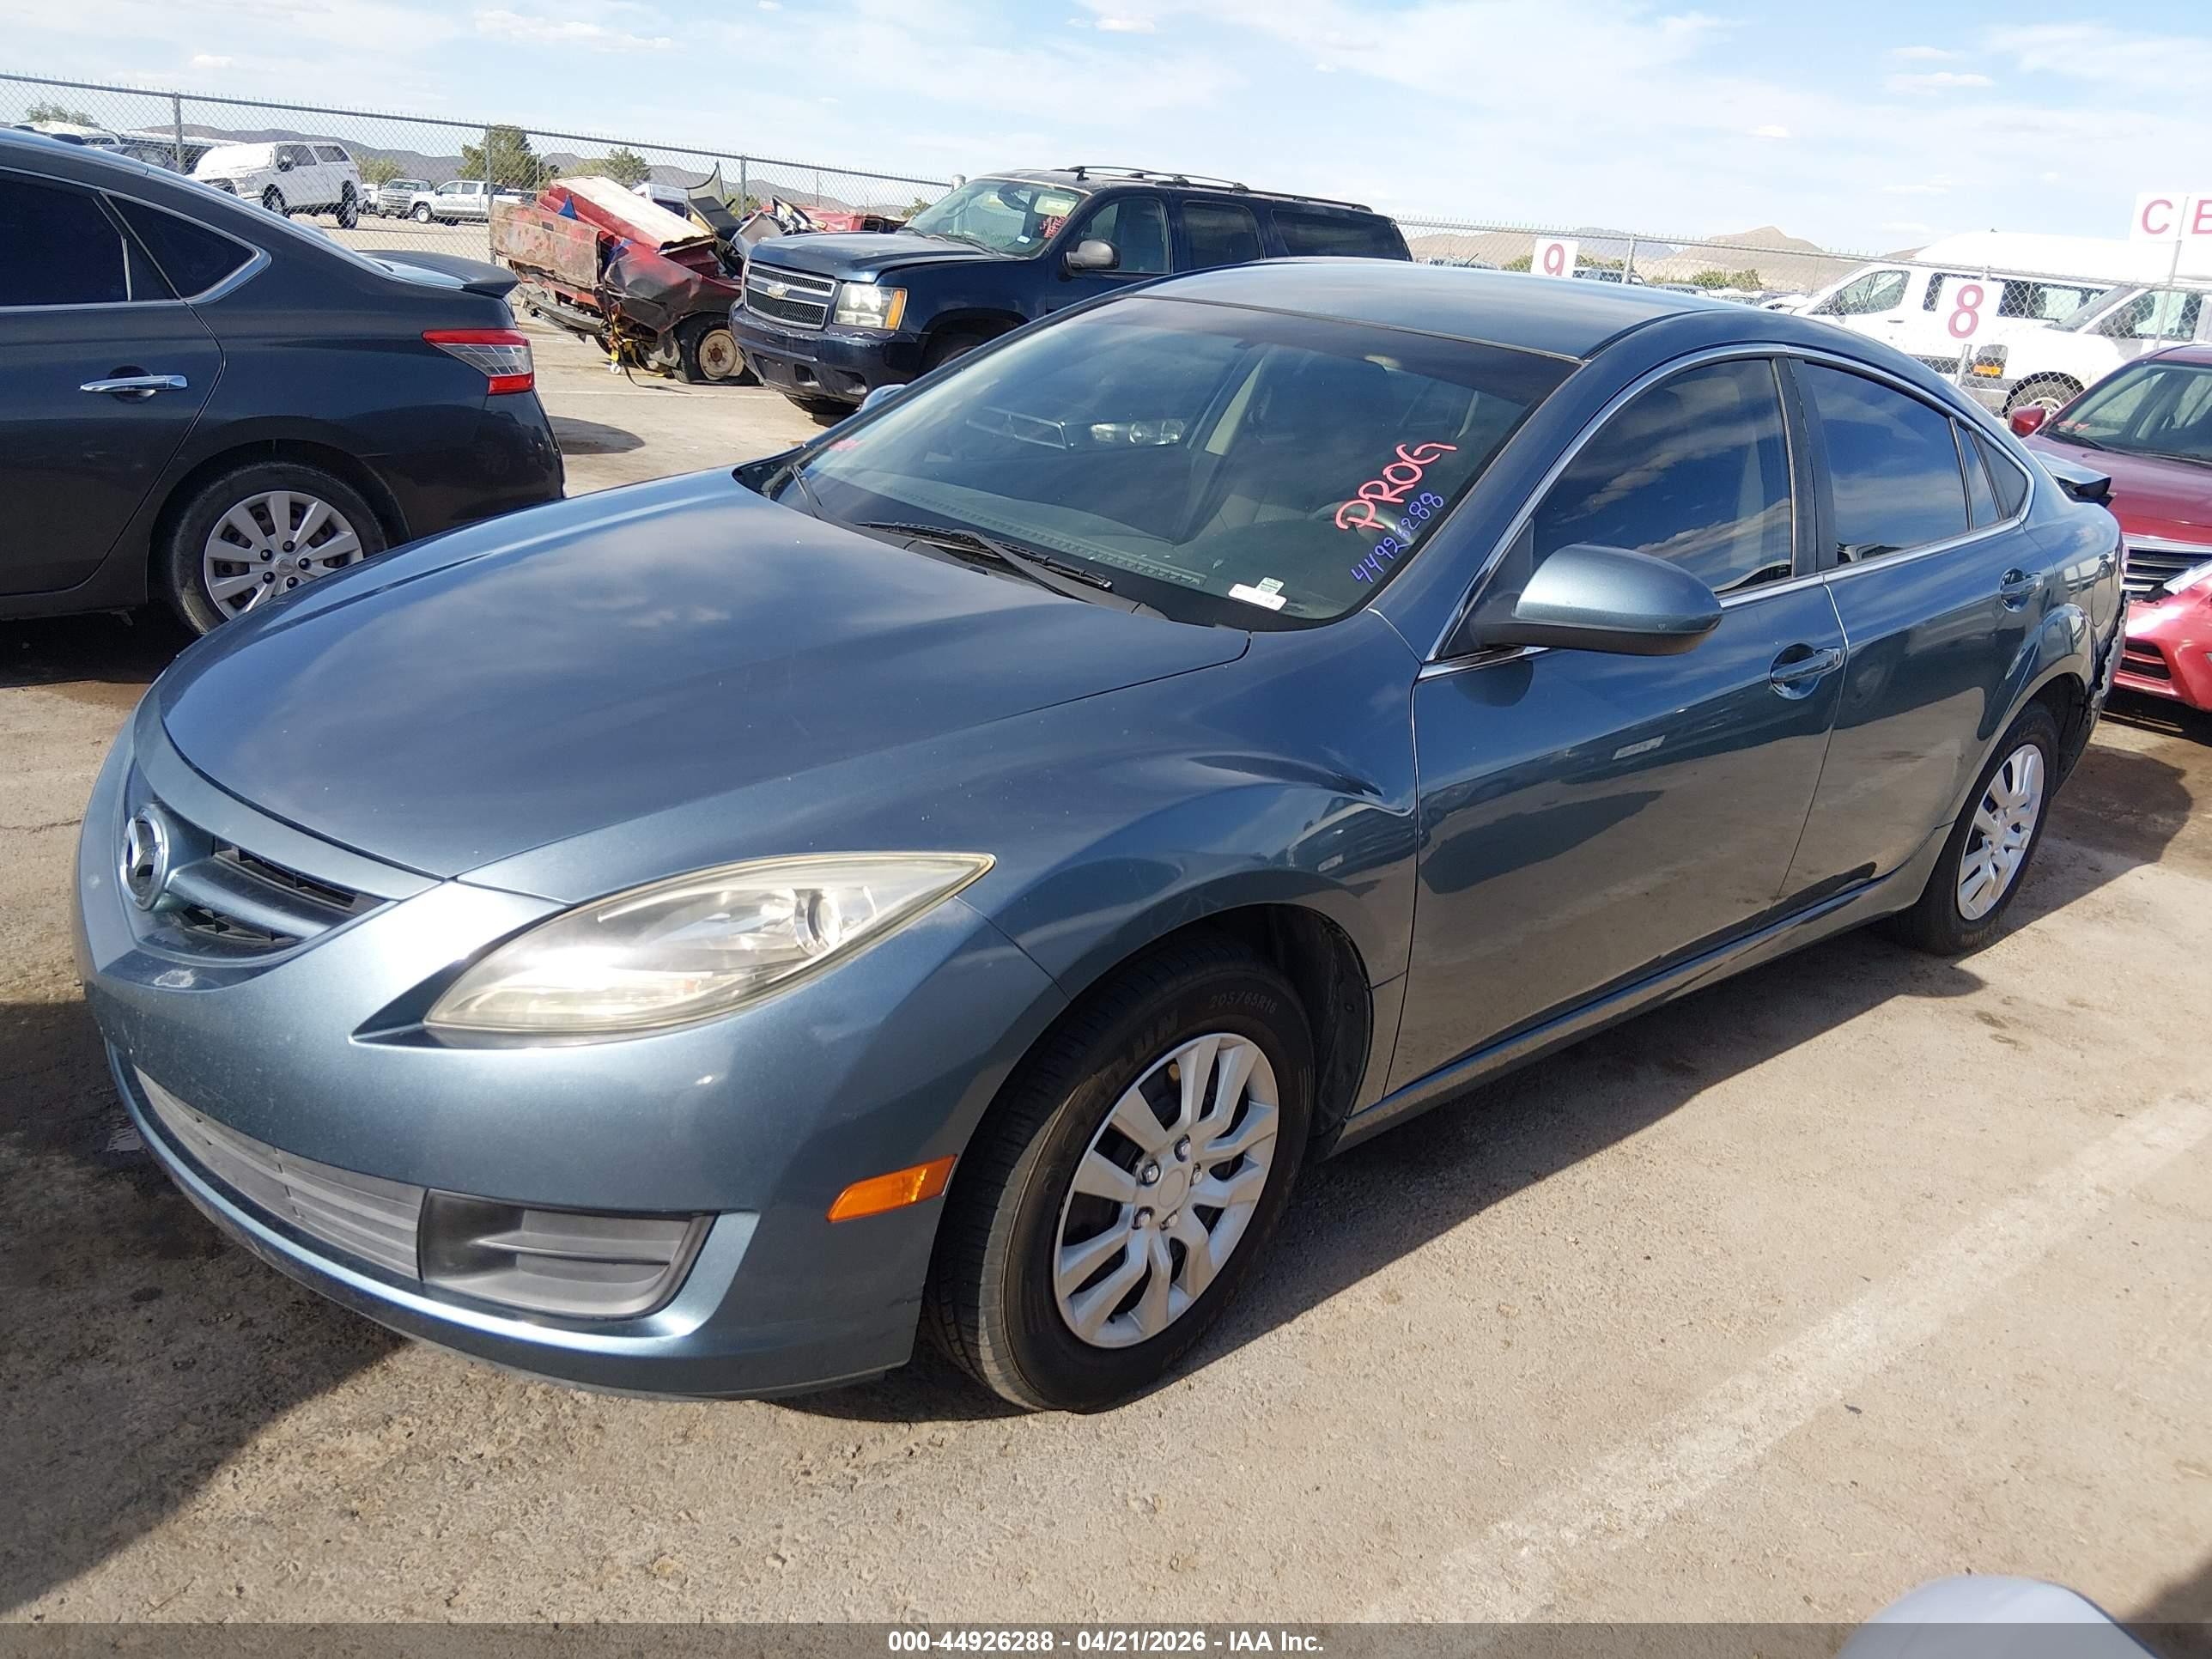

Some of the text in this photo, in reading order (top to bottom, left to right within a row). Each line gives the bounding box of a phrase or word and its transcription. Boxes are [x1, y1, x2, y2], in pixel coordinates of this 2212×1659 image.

[2142, 199, 2173, 234] C
[1544, 243, 1565, 276] 9
[1948, 284, 1984, 338] 8
[1335, 442, 1457, 530] PROG
